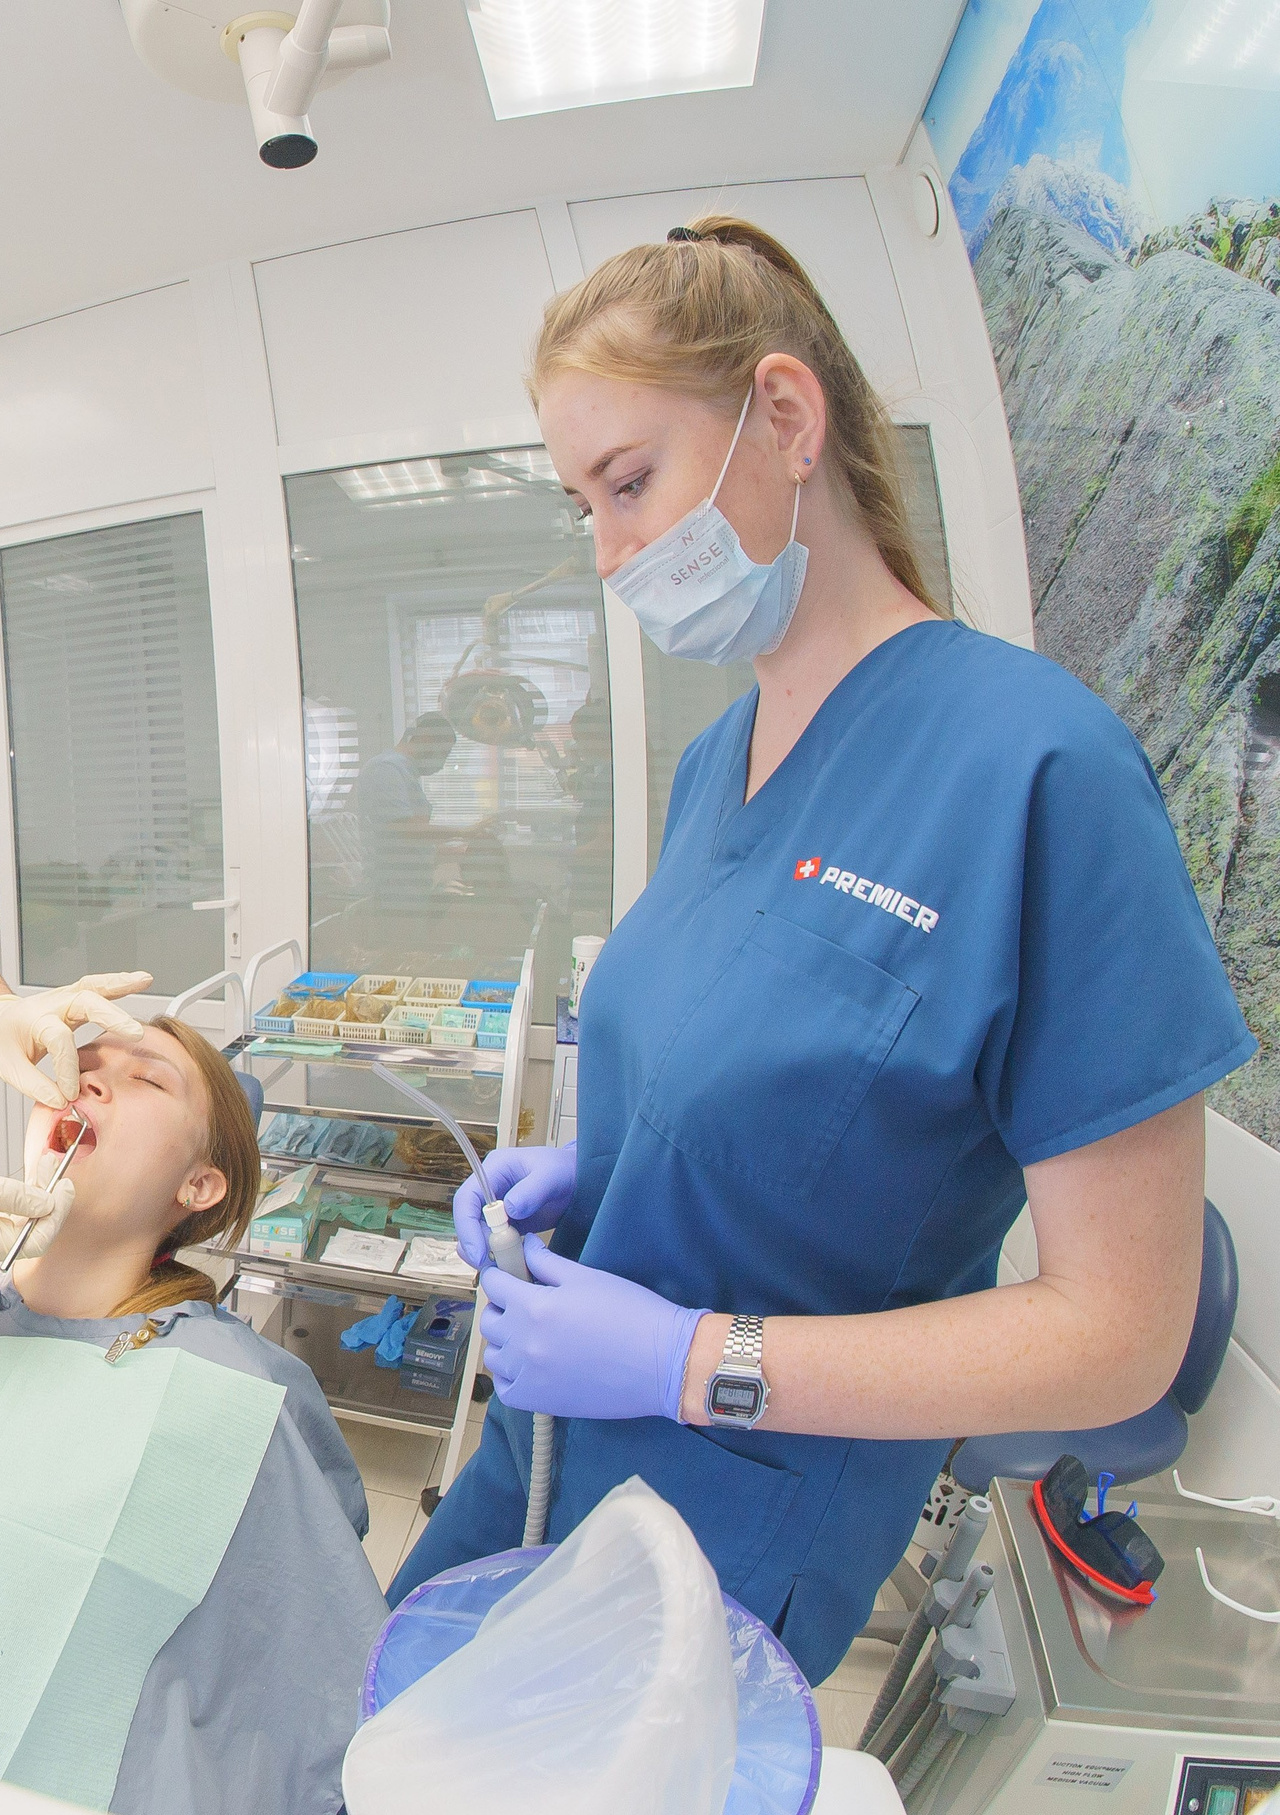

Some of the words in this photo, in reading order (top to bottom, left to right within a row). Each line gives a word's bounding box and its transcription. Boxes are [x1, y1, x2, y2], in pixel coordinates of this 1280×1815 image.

[670, 542, 723, 585] SENSE
[697, 556, 730, 584] professional
[819, 866, 940, 934] PREMIER
[254, 1223, 296, 1236] SENSE
[1052, 1761, 1083, 1769] SUCTION
[1085, 1764, 1126, 1772] EQUIPMENT
